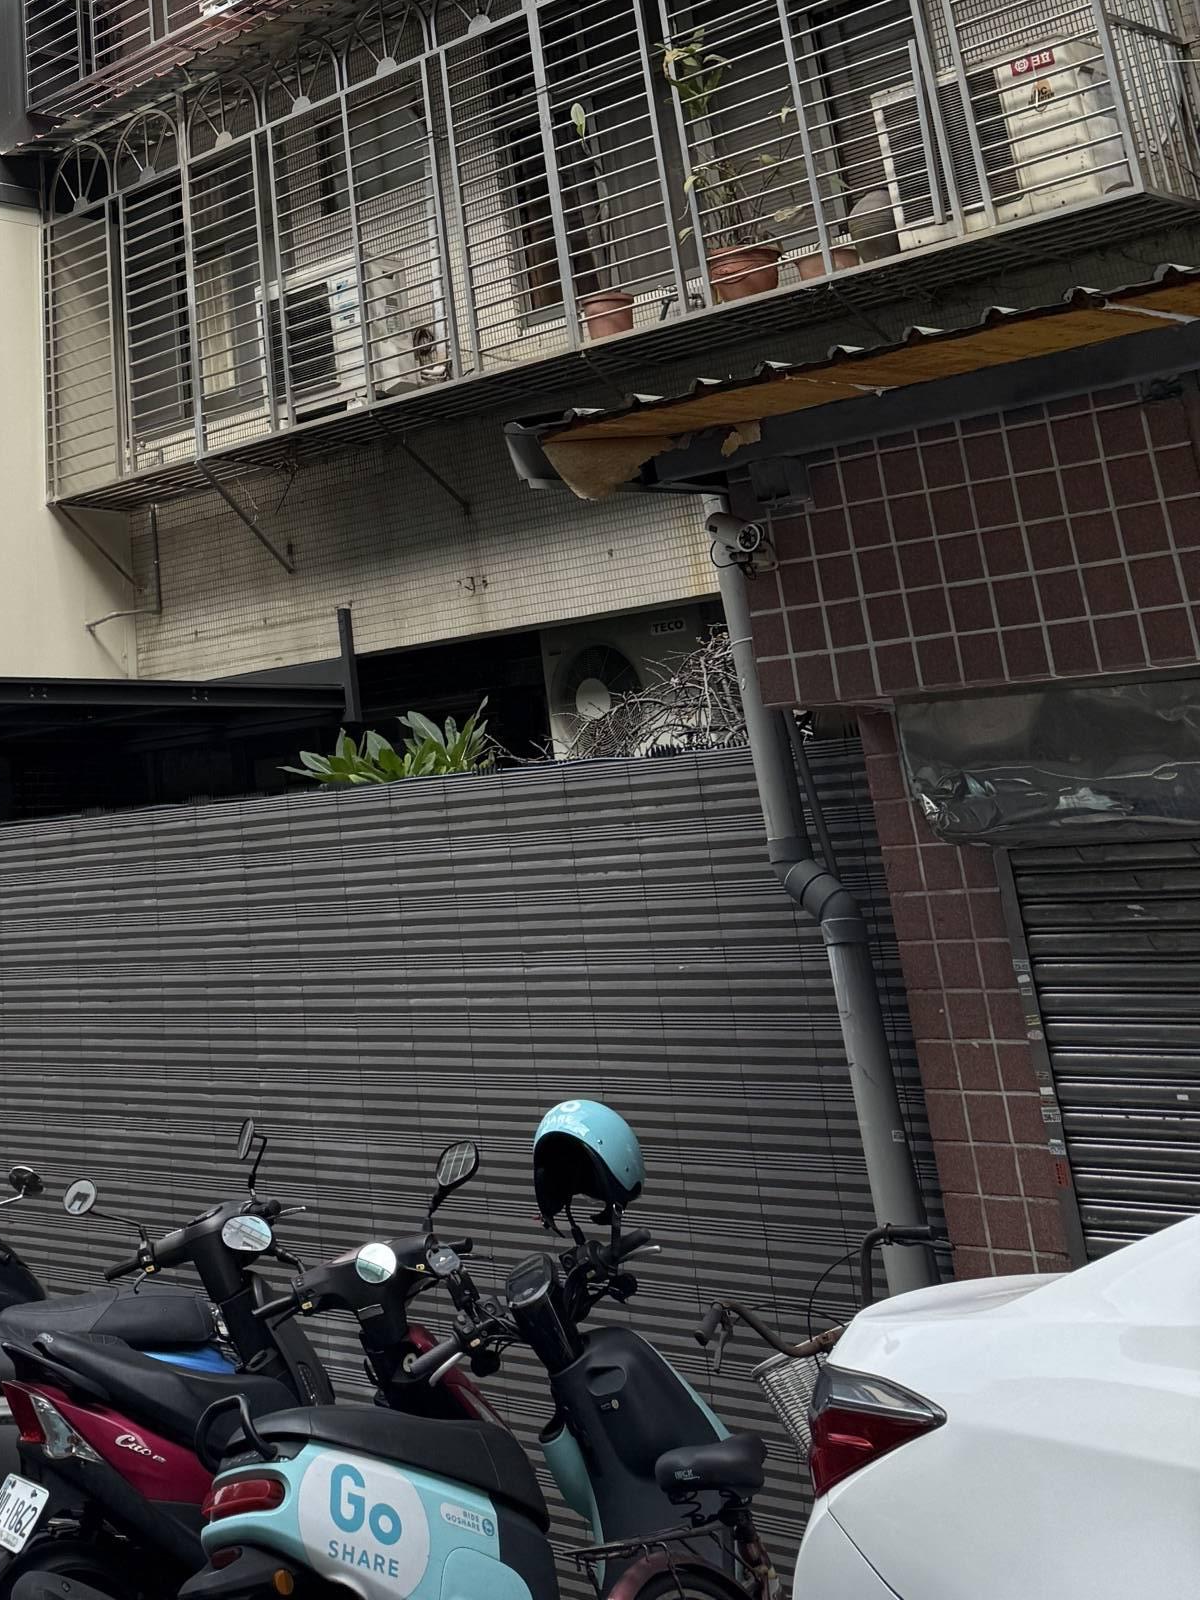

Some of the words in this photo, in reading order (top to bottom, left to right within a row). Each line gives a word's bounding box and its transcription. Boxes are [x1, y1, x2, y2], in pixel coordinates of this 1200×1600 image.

[1031, 51, 1051, 67] 日立
[652, 620, 684, 633] TECO
[329, 1463, 403, 1546] Go
[445, 1512, 481, 1532] GOSHARE
[462, 1510, 480, 1523] RIDE
[328, 1540, 400, 1578] SHARE
